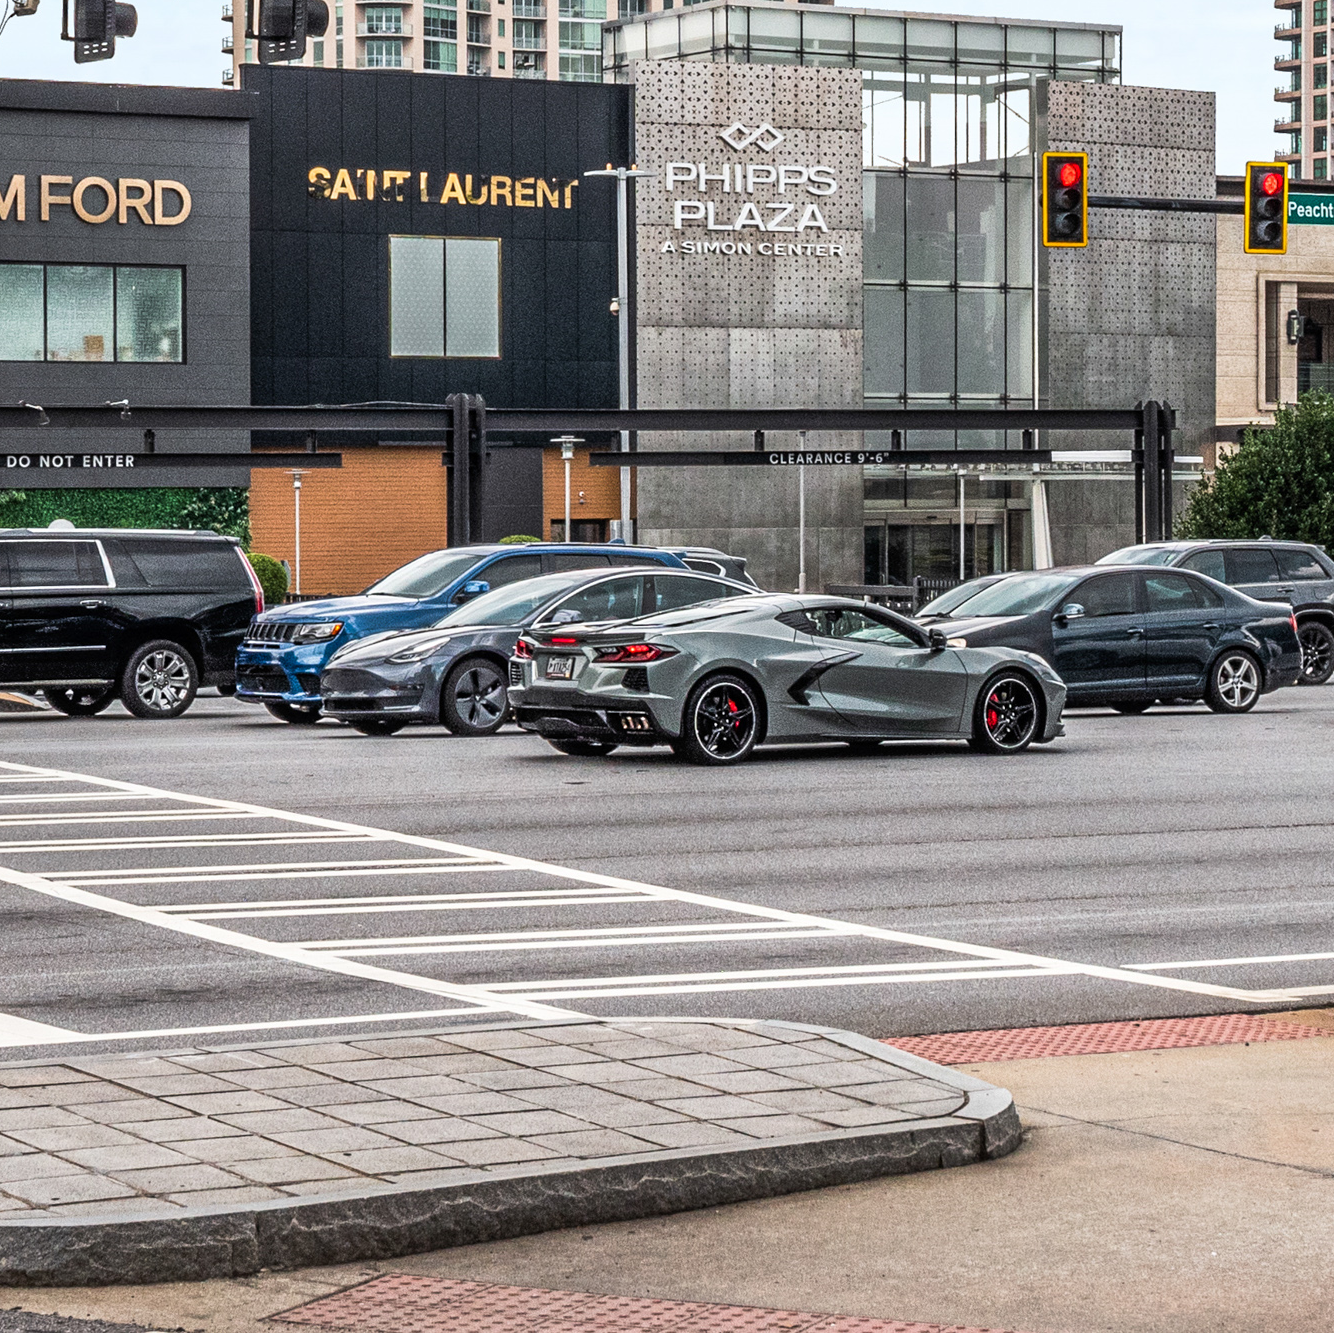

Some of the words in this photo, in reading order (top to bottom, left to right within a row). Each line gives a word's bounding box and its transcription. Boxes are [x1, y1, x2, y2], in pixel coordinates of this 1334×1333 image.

[420, 171, 579, 209] LAURENT
[666, 162, 838, 196] PHIPPS
[41, 174, 192, 225] FORD
[673, 200, 829, 233] PLAZA
[660, 241, 676, 254] A
[681, 241, 752, 255] SIMON
[758, 243, 844, 257] CENTER
[7, 456, 31, 468] DO
[39, 456, 74, 468] NOT
[82, 455, 135, 467] ENTER
[769, 453, 852, 465] CLEARANCE
